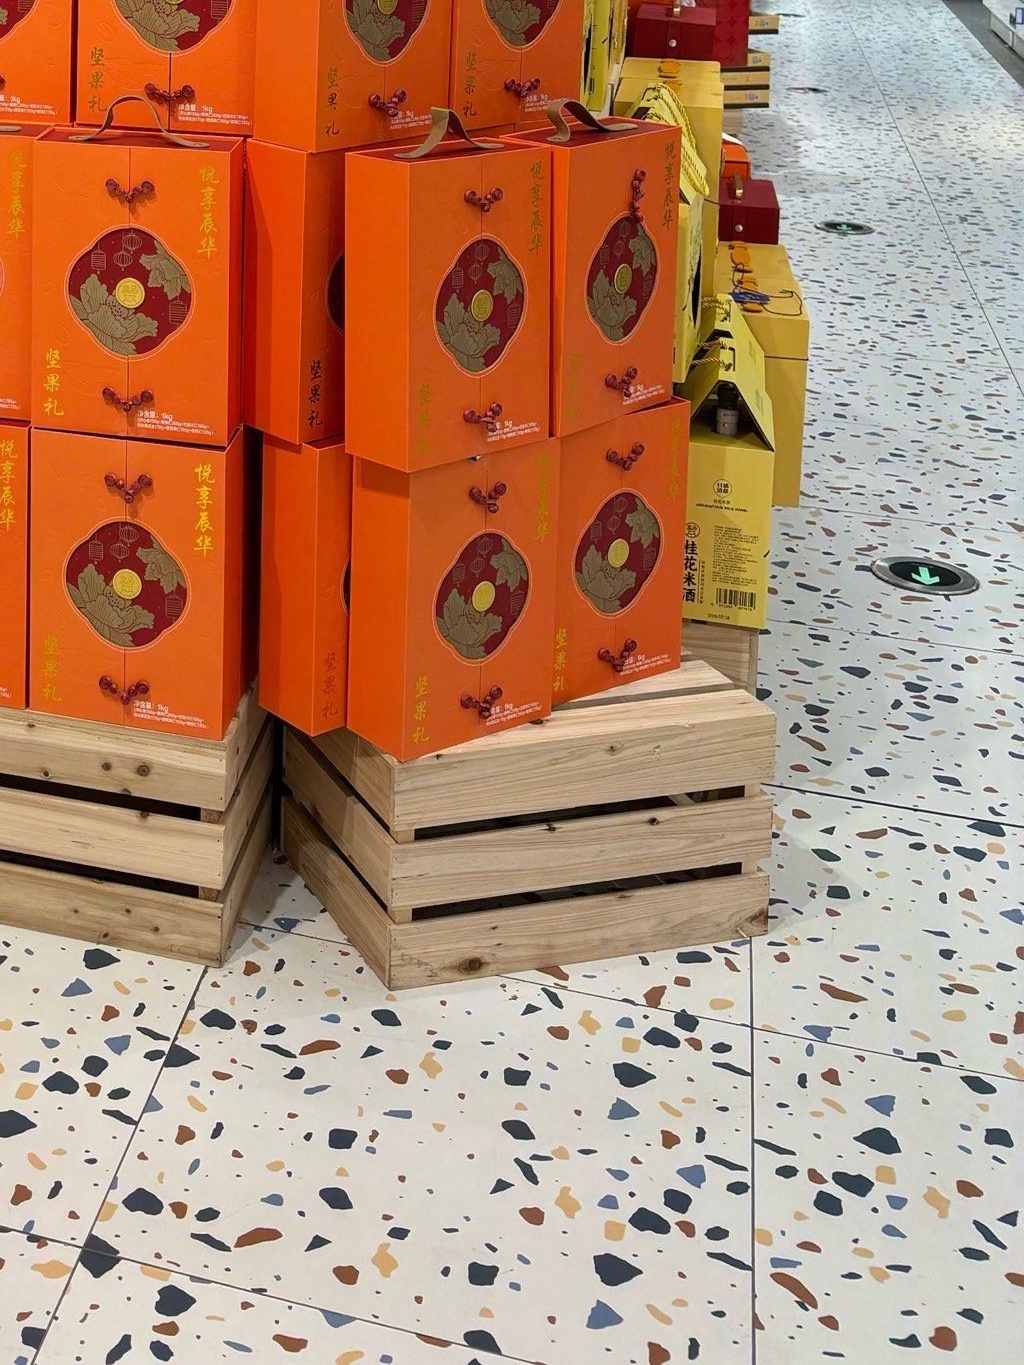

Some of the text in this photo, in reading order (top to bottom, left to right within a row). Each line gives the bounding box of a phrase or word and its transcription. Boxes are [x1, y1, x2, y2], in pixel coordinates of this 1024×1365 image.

[87, 46, 107, 113] 坚果礼
[43, 348, 64, 417] 坚果礼
[307, 359, 324, 428] 坚果礼
[193, 464, 216, 558] 悦享辰华
[682, 540, 698, 603] 桂花米酒
[413, 676, 431, 745] 坚果礼
